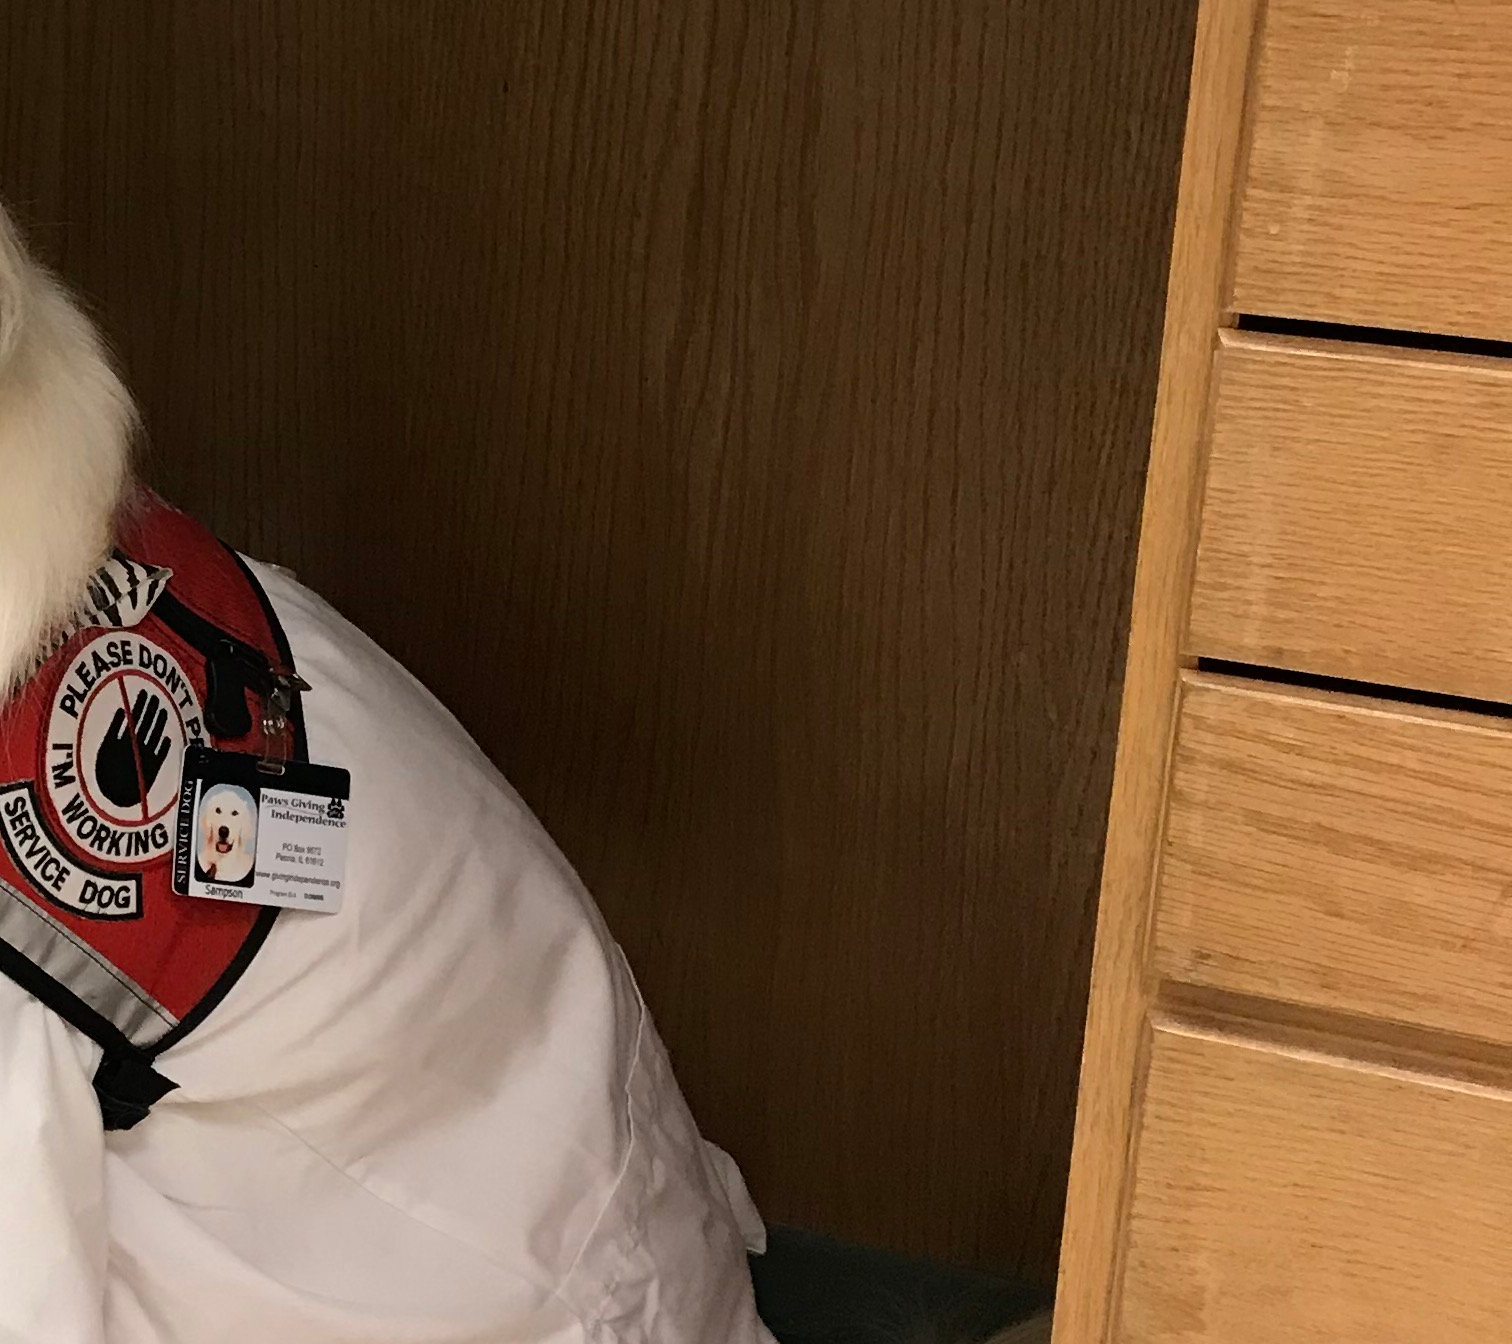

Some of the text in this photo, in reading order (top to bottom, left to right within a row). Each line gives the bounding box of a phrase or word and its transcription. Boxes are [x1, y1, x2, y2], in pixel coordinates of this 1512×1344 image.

[60, 640, 204, 748] PLEASE DON'T PE
[4, 796, 131, 908] SERVICE DOG
[52, 743, 169, 858] I'M WORKING
[177, 780, 194, 885] SERVICE DOG
[261, 793, 326, 815] Paws Giving
[271, 809, 347, 828] Independence
[205, 884, 244, 899] Sampson
